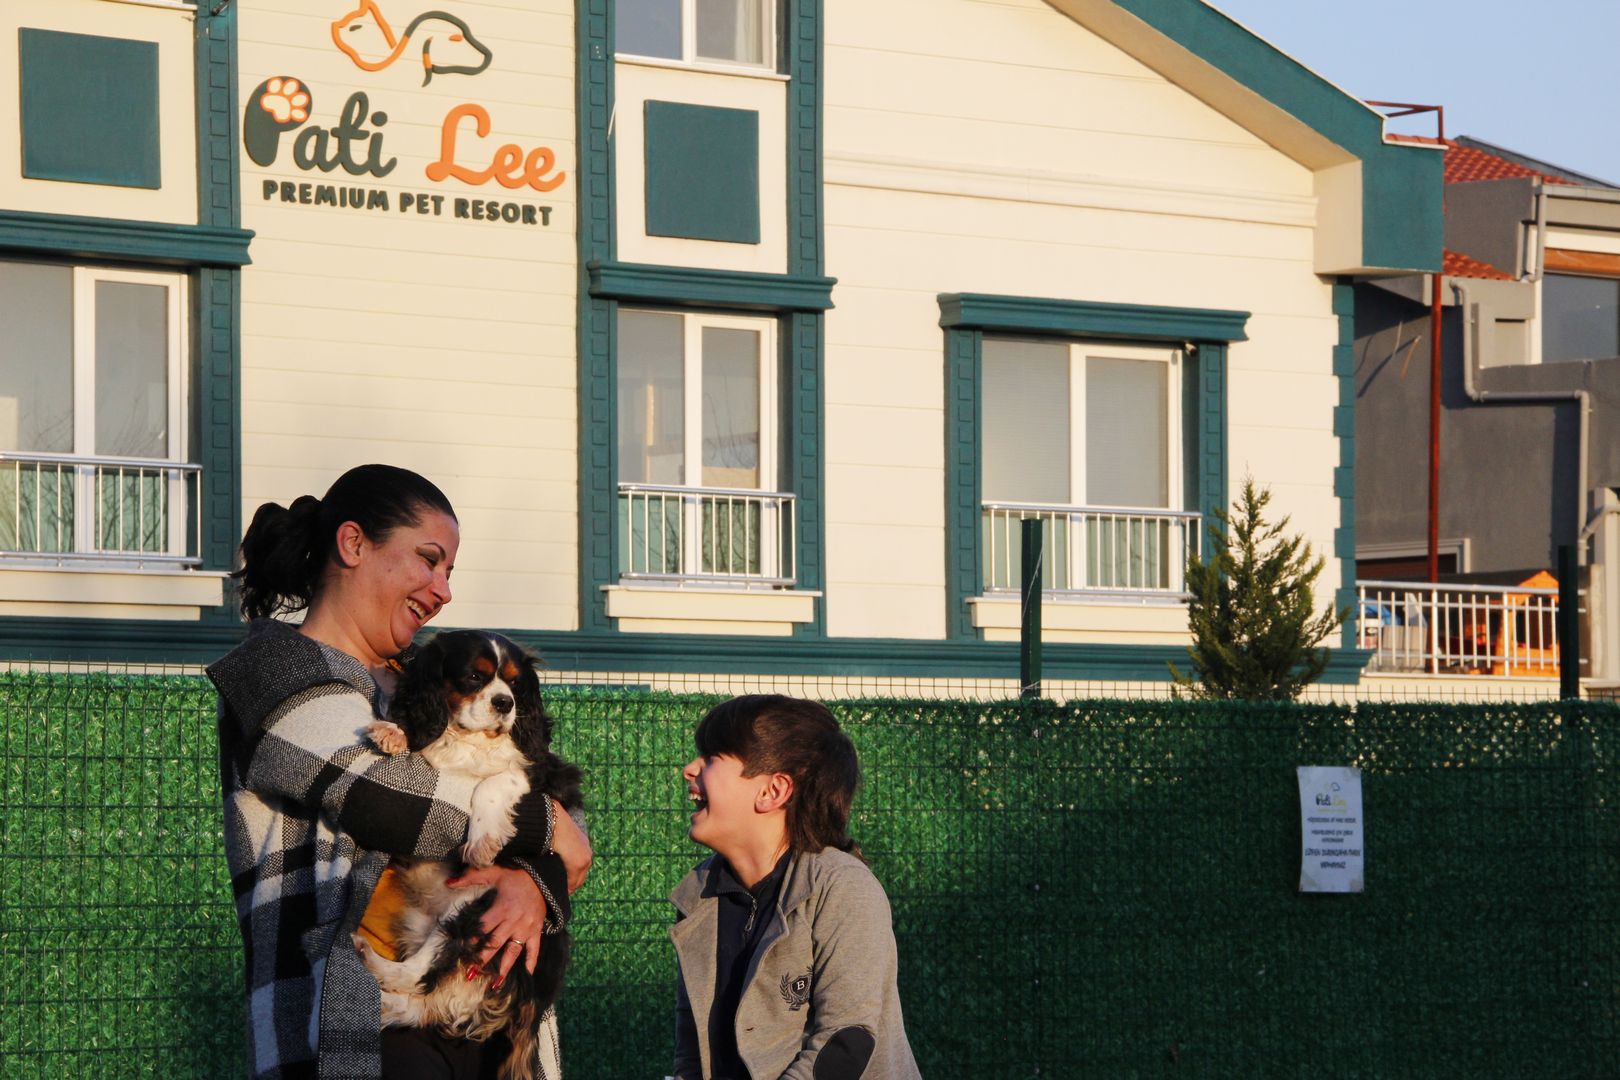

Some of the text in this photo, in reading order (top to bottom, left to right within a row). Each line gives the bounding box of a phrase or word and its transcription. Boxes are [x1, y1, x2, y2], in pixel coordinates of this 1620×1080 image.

[243, 75, 567, 193] Pati Lee
[262, 179, 553, 227] PREMIUM PET RESORT
[796, 980, 805, 991] B
